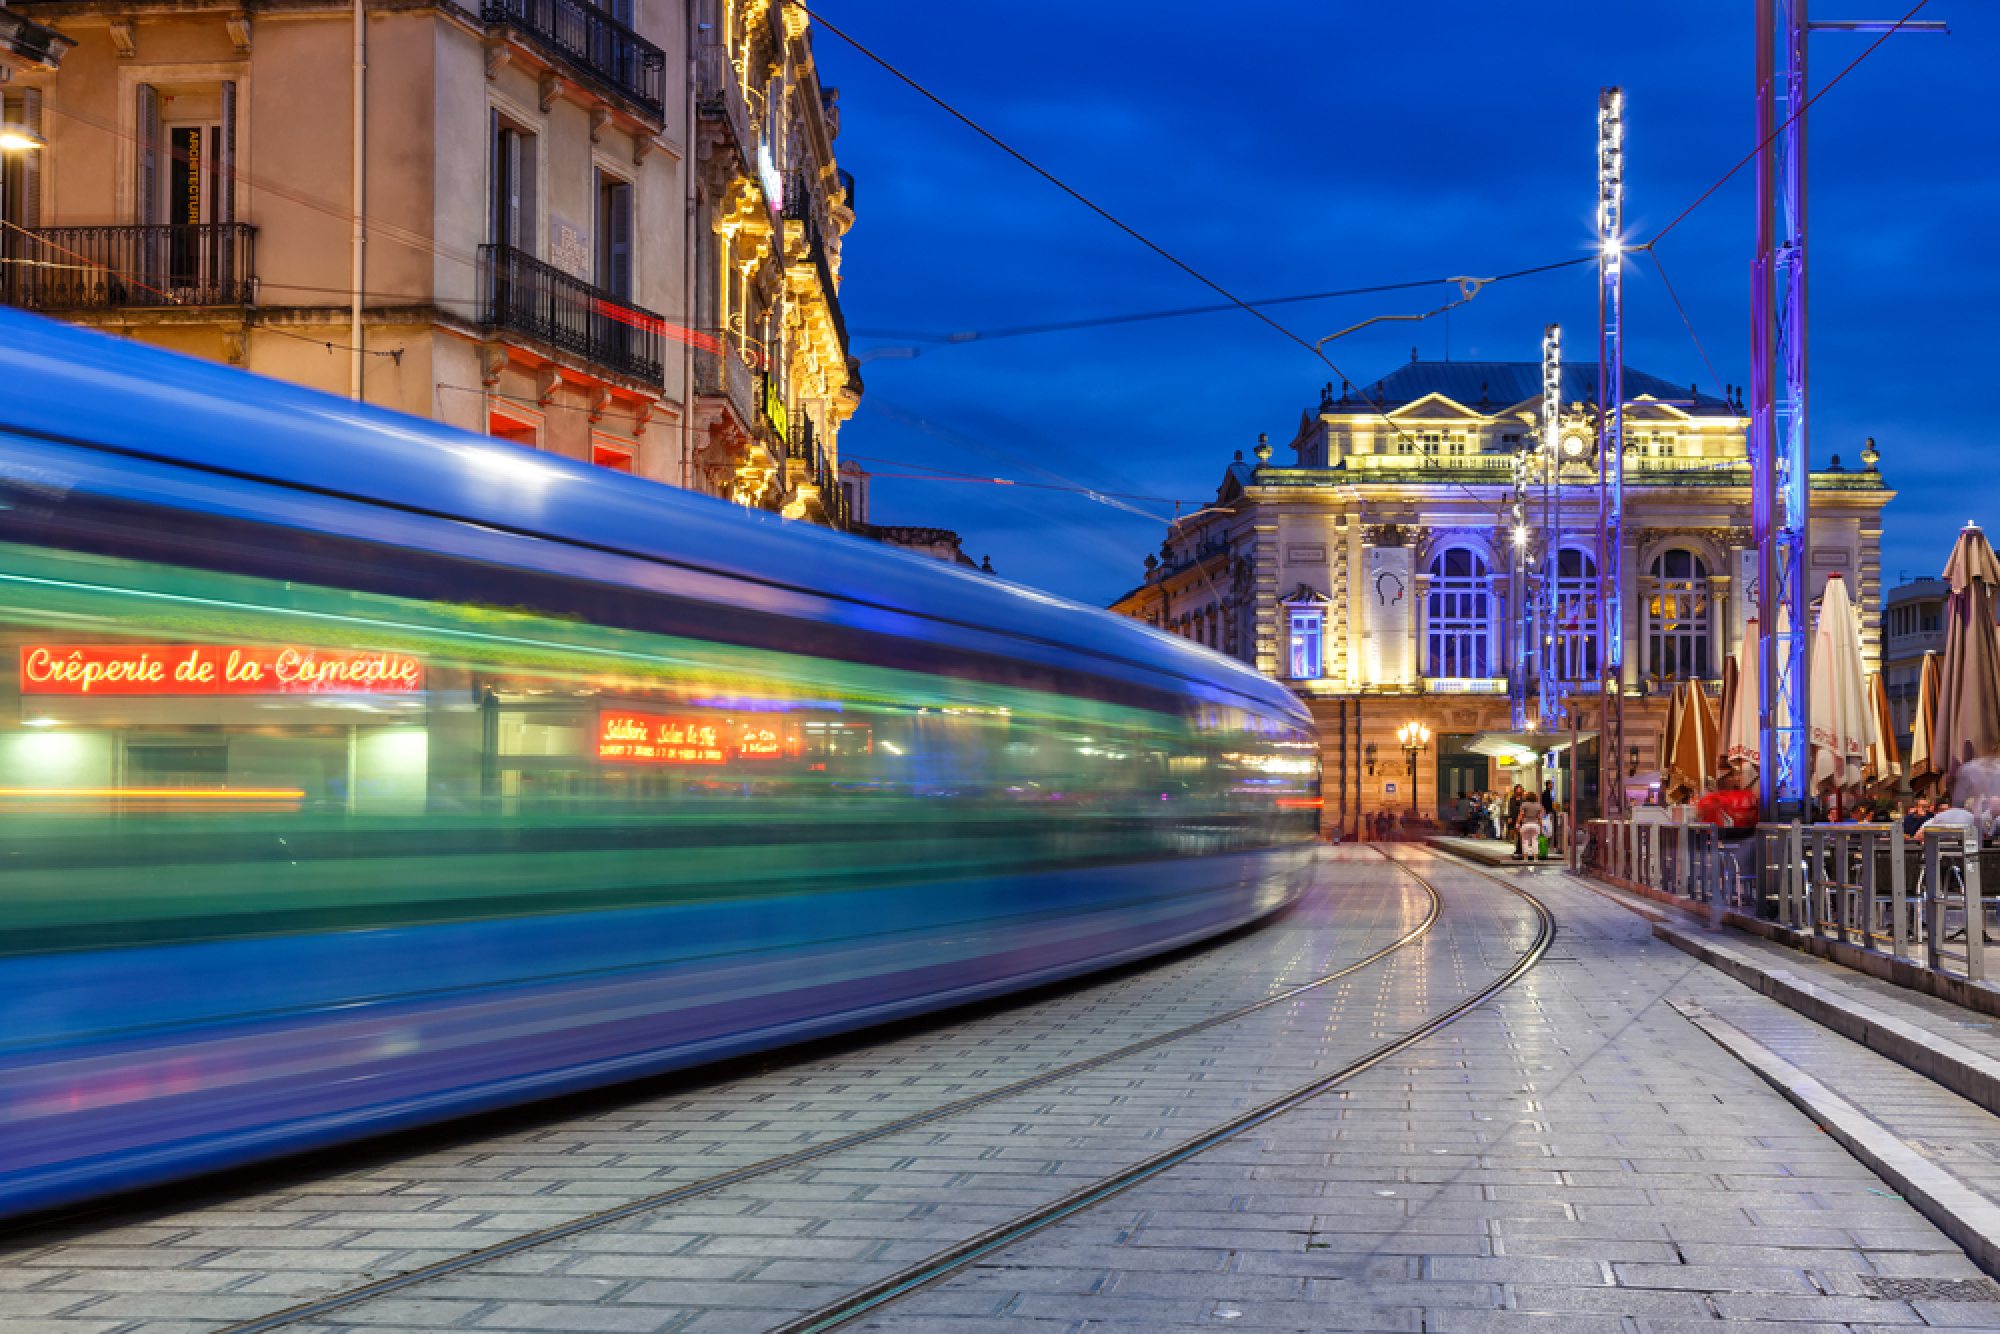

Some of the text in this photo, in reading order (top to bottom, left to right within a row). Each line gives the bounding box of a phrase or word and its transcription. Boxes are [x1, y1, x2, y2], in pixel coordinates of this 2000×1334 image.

[26, 648, 419, 693] Crêperie de la Comédie
